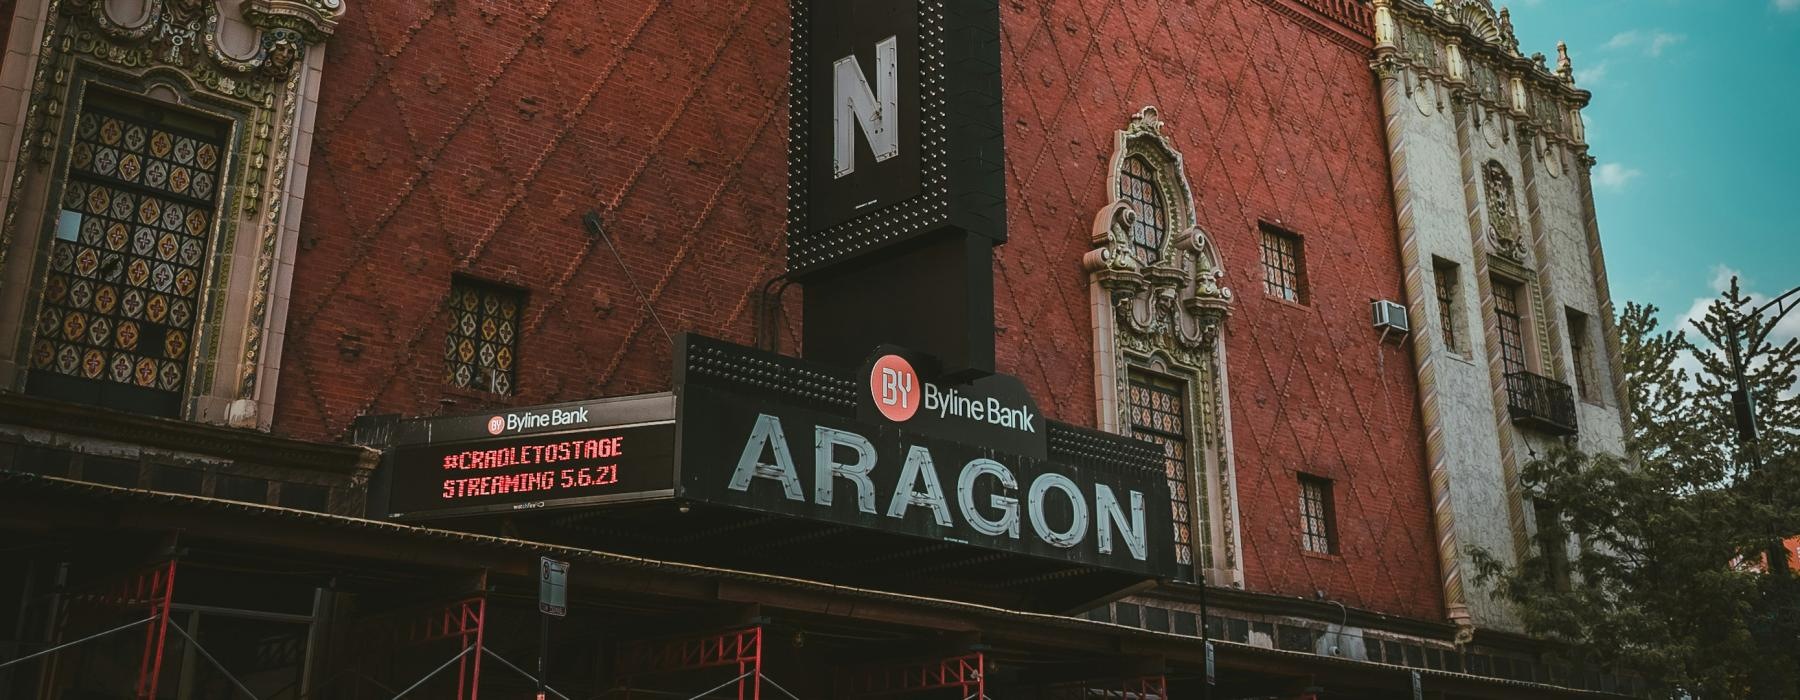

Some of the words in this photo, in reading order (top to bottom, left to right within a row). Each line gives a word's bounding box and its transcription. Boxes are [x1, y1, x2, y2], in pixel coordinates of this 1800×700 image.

[833, 35, 899, 180] N
[506, 413, 550, 432] Byline
[552, 407, 588, 426] Bank
[882, 367, 911, 409] BY
[924, 382, 985, 421] Byline
[987, 397, 1035, 433] Bank
[443, 436, 623, 470] #CRADLETOSTAGE
[442, 471, 555, 499] STREAMING
[560, 463, 618, 488] 5.6.21
[729, 413, 1147, 561] ARAGON
